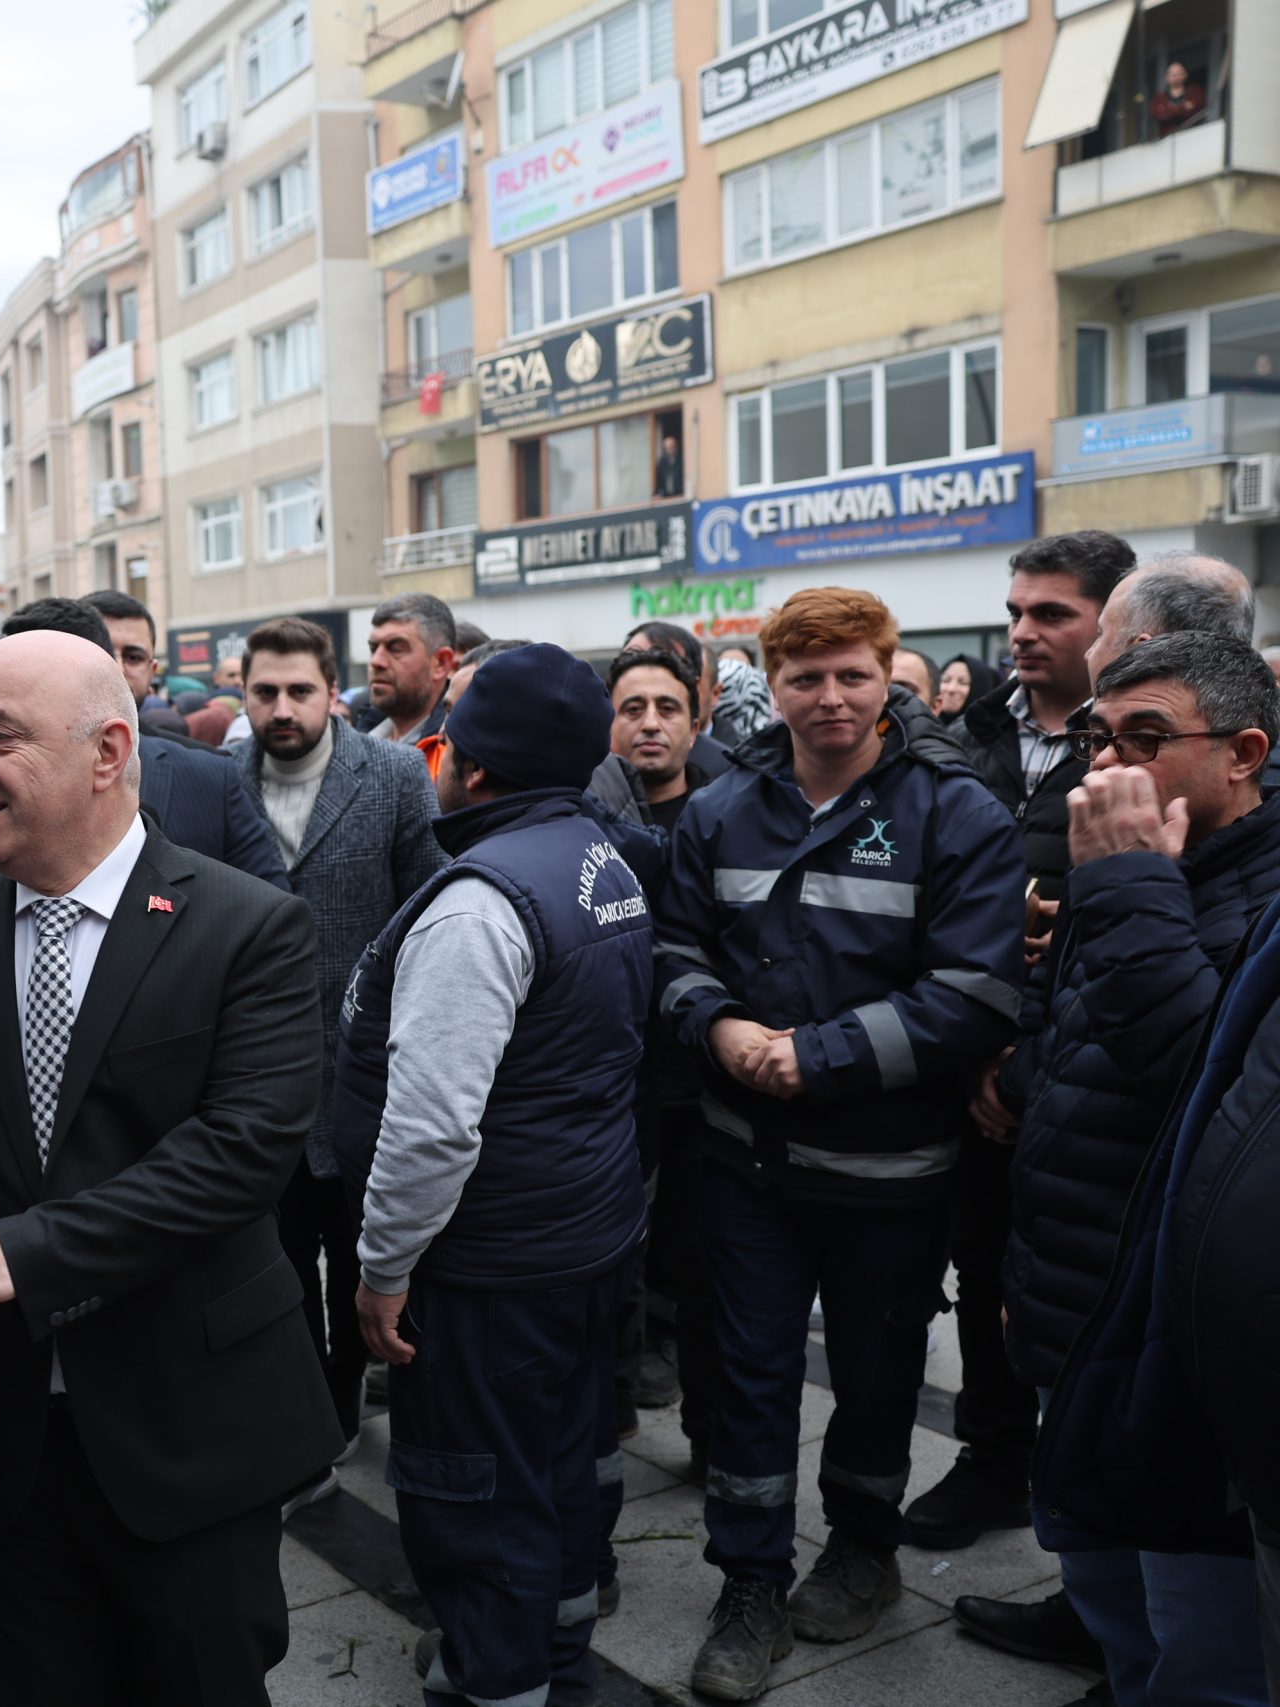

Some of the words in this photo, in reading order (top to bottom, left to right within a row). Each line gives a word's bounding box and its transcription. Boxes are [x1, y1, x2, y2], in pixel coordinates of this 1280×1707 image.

[747, 2, 890, 87] BAYKARA
[495, 153, 549, 199] ALFA
[741, 482, 895, 539] ÇETİNKAYA
[900, 463, 1023, 517] İNŞAAT
[585, 842, 608, 869] İÇİN
[852, 849, 891, 861] DARICA
[578, 858, 598, 911] DARICA
[594, 900, 625, 925] DARICA
